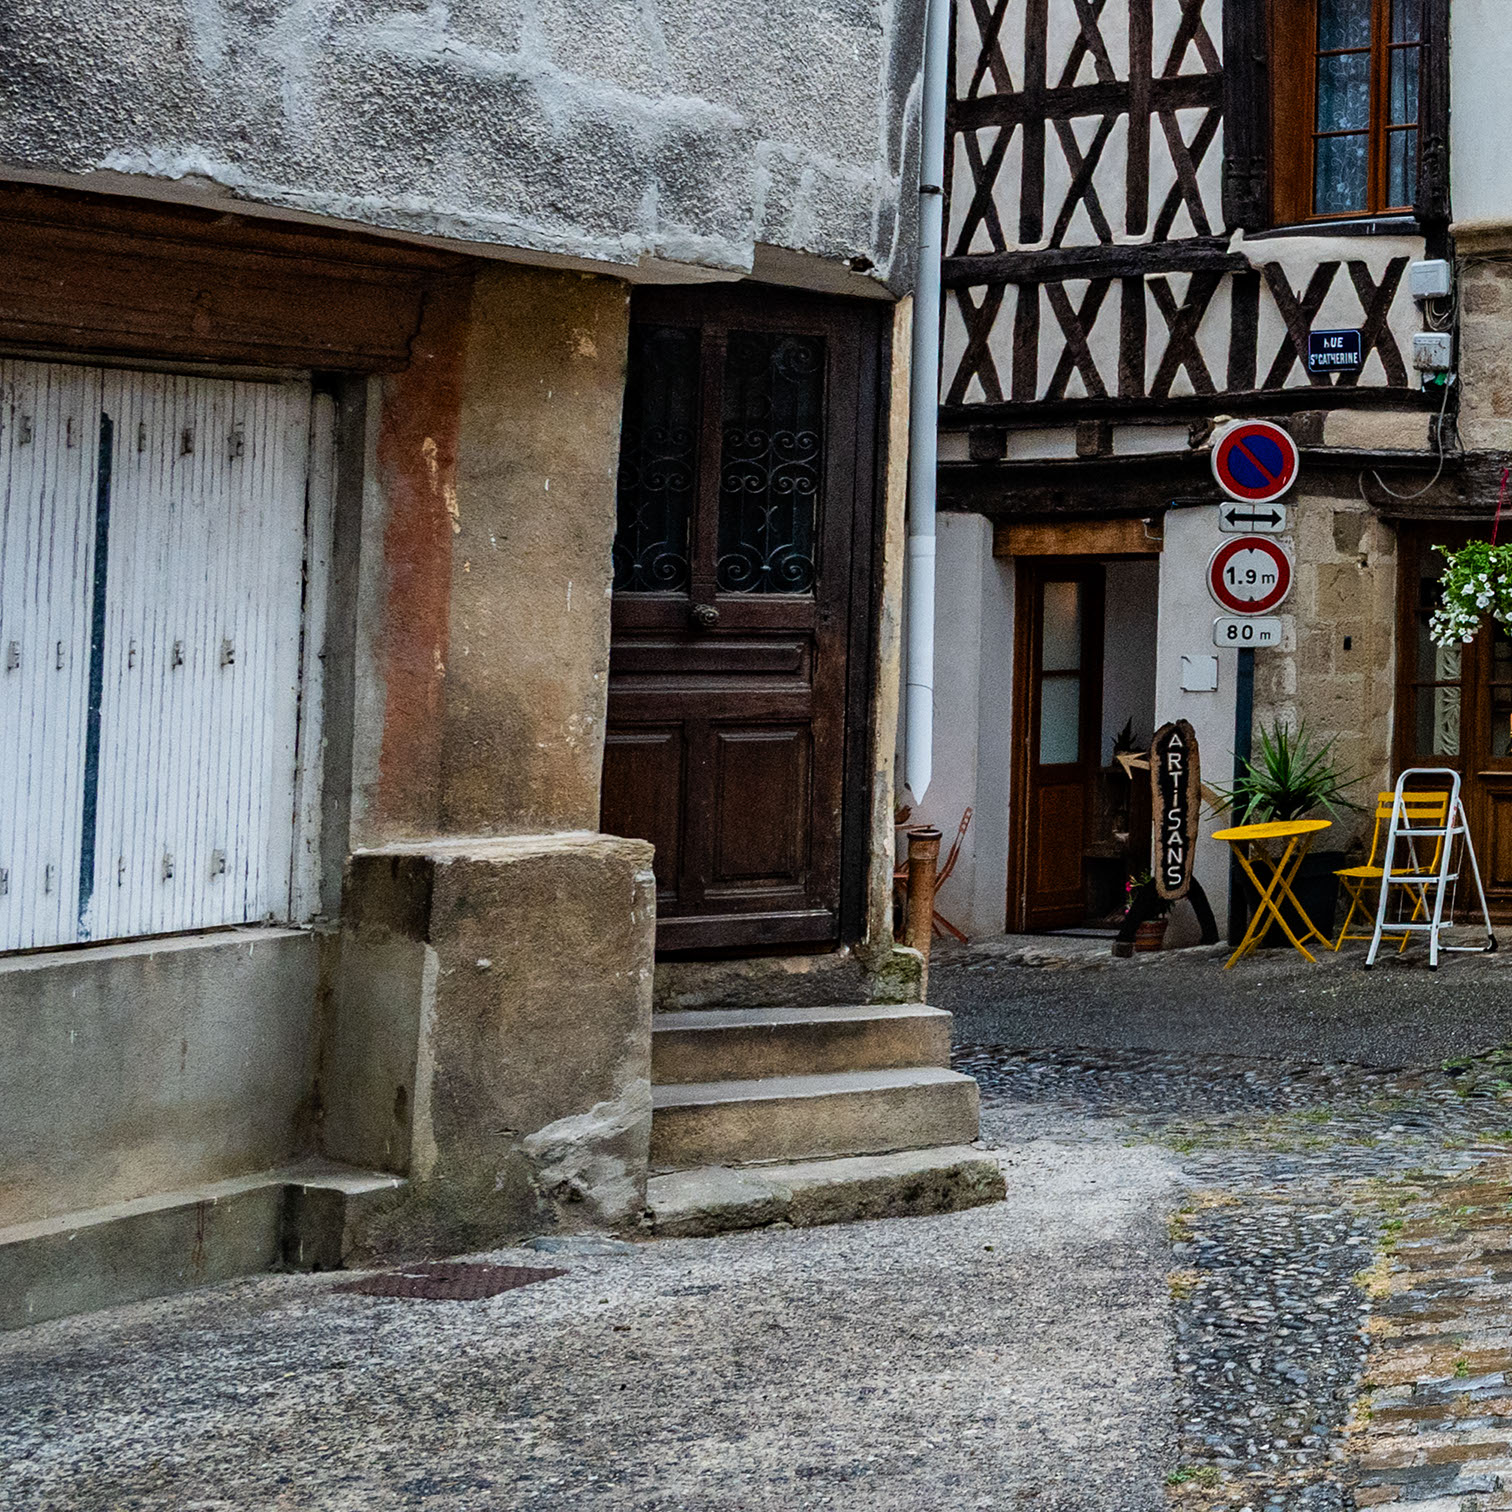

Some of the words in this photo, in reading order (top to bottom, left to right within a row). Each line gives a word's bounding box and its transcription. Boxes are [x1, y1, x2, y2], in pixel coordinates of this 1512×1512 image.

[1226, 566, 1257, 585] 1.9
[1262, 573, 1276, 584] m
[1227, 624, 1254, 640] 80
[1260, 631, 1271, 640] m
